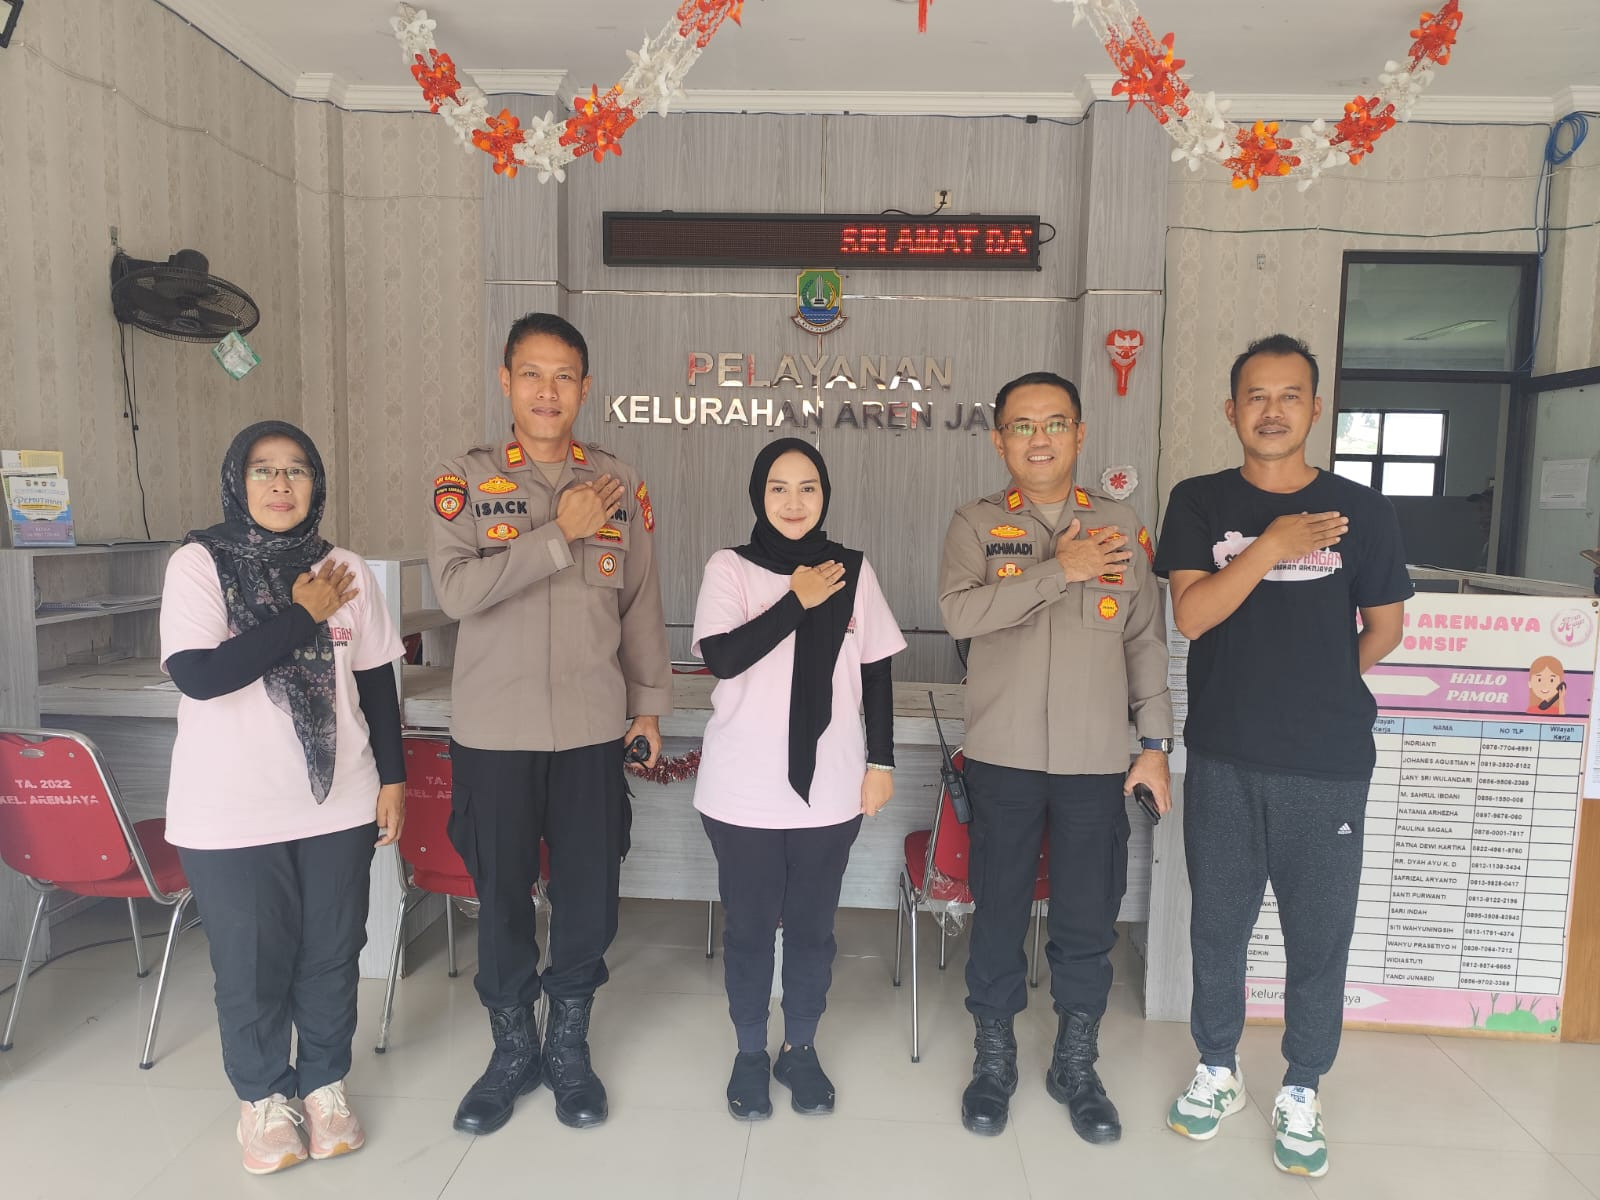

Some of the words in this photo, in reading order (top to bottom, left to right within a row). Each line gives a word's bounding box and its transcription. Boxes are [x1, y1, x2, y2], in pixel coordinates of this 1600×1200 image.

[688, 352, 951, 391] PELAYANAN
[604, 394, 824, 429] KELURAHAN
[834, 400, 933, 430] AREN
[476, 500, 528, 518] ISACK
[986, 542, 1032, 558] AKHMADI
[1417, 613, 1540, 632] ARENJAYA
[1402, 635, 1468, 652] ONSIF
[1450, 672, 1508, 686] HALLO
[1446, 690, 1509, 704] PAMOR
[15, 779, 38, 788] TA.
[40, 779, 72, 788] 2022
[426, 776, 448, 785] TA.
[1432, 776, 1472, 784] WULANDARI
[30, 796, 100, 806] ARENJAYA
